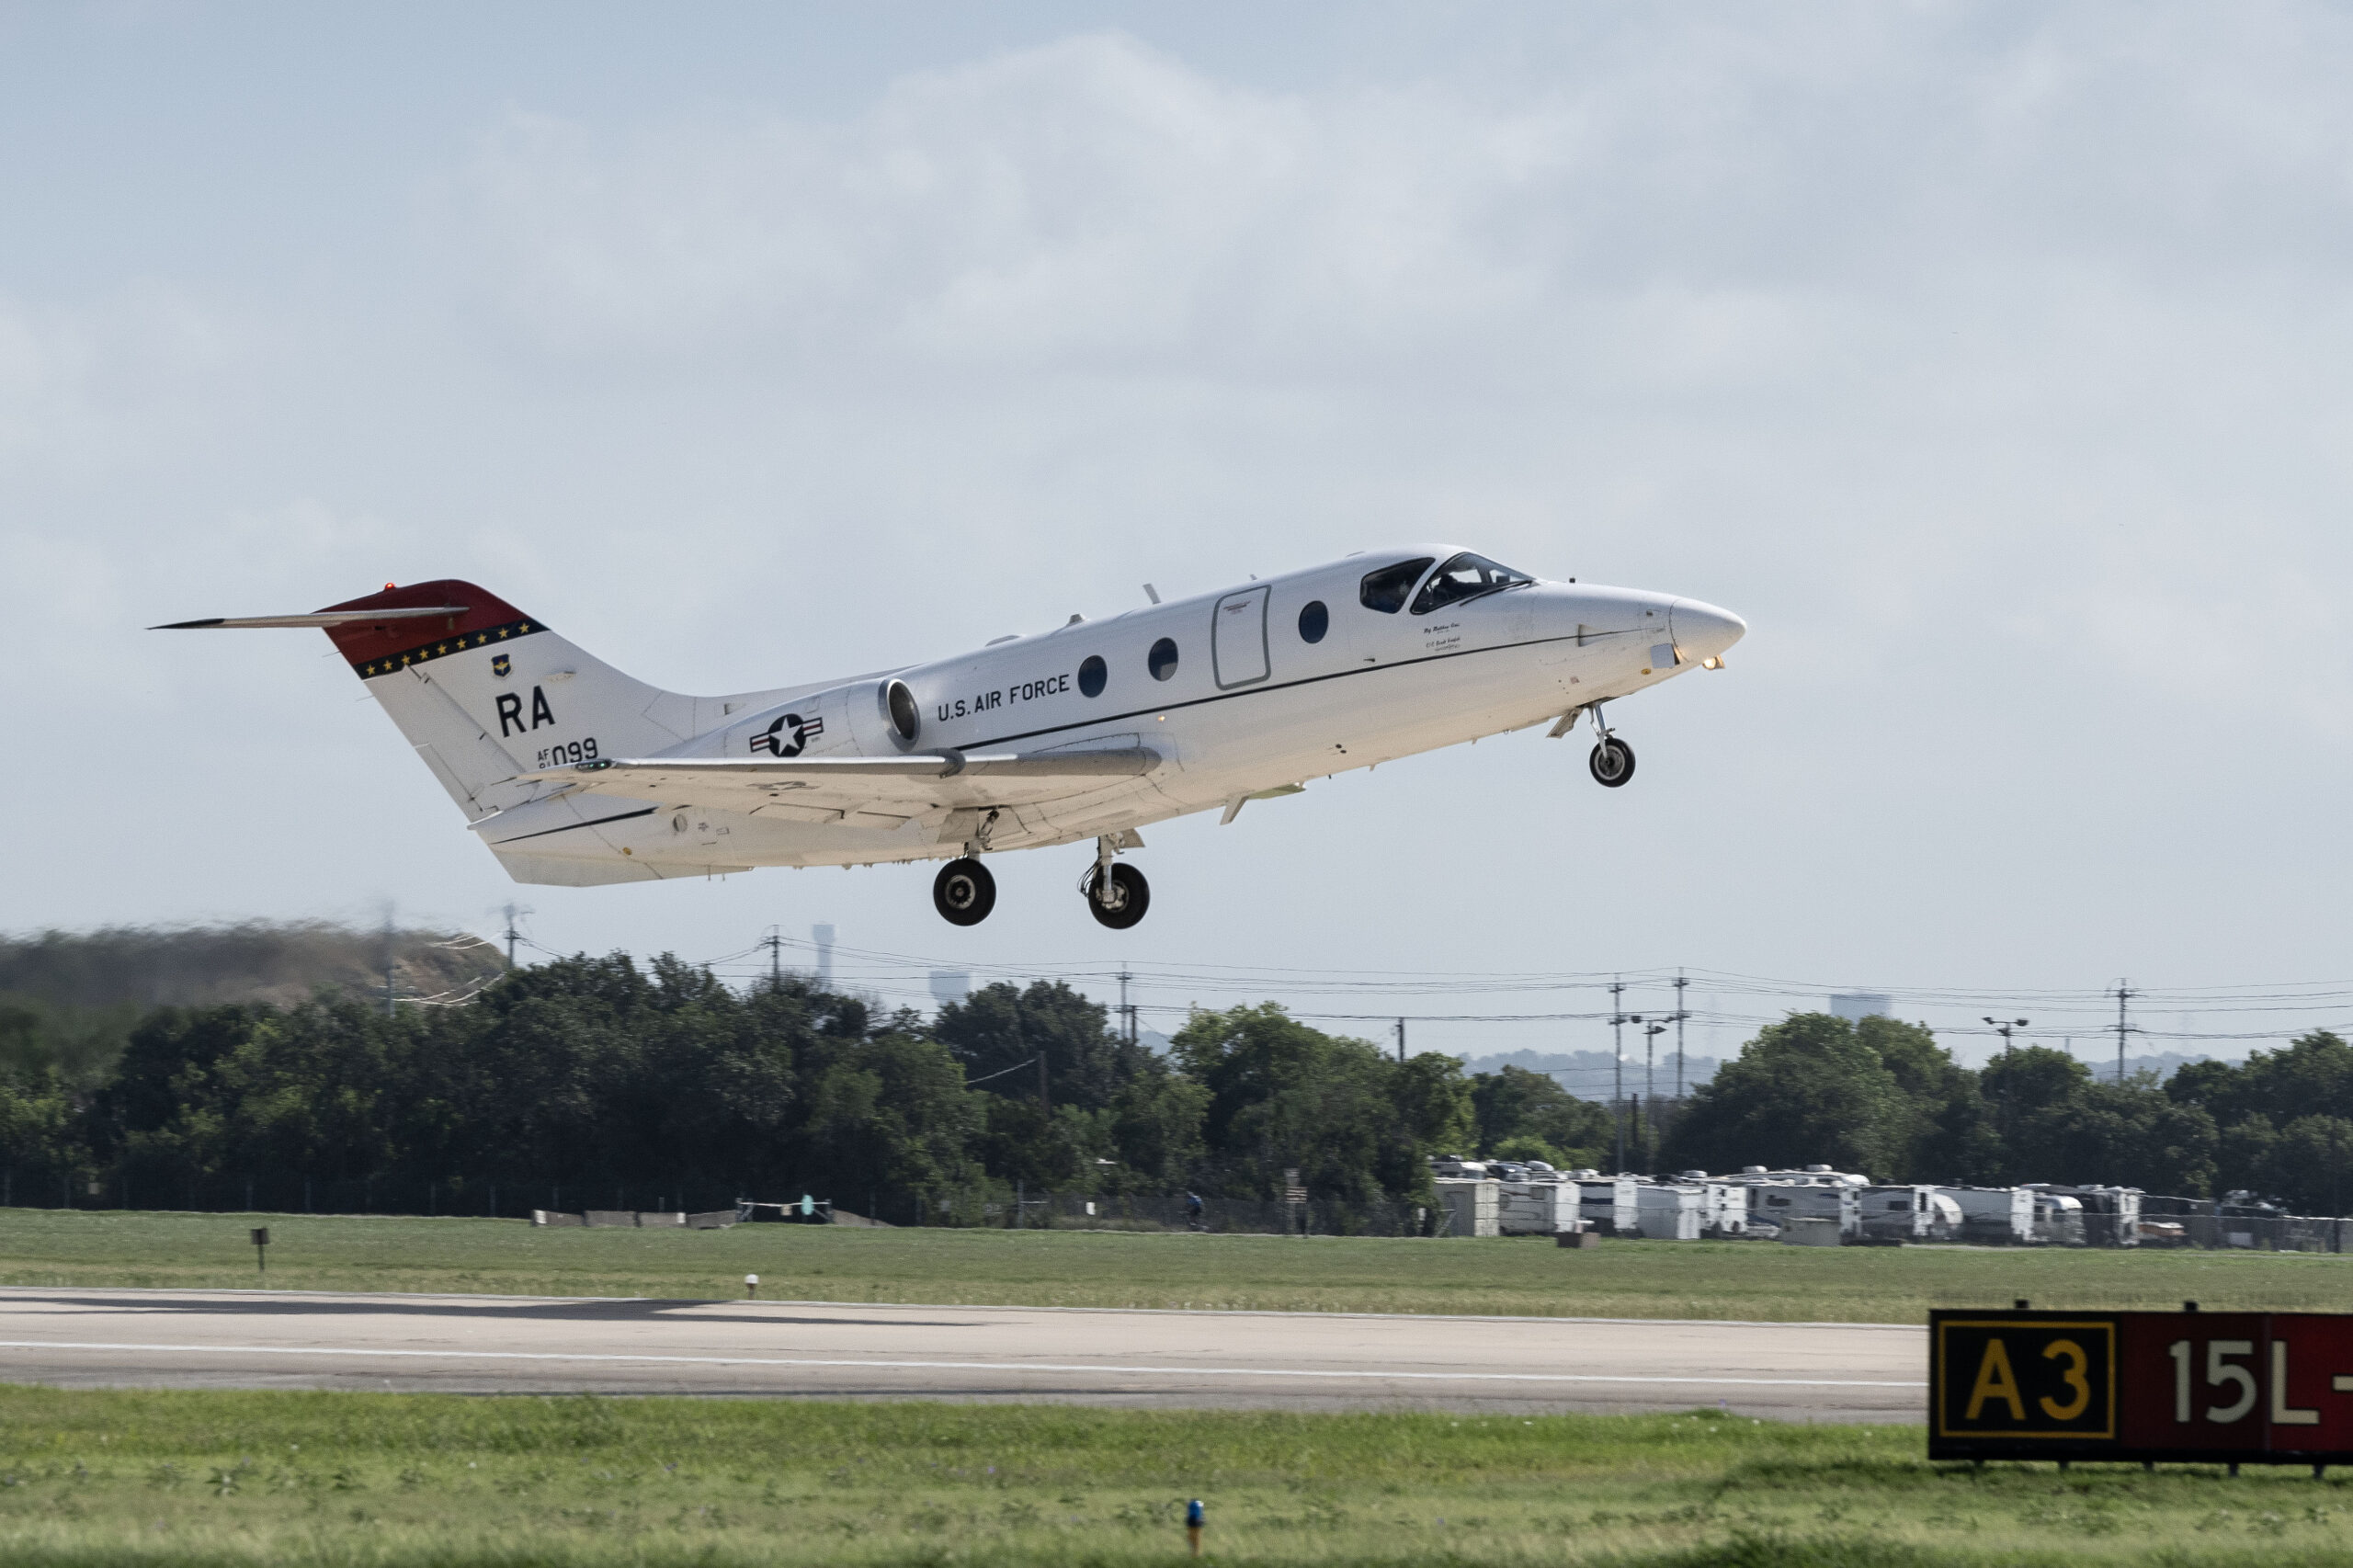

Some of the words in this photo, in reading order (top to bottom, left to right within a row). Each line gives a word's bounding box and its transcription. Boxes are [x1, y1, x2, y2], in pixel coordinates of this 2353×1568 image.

[494, 684, 556, 738] RA
[938, 699, 971, 722] U.S.
[974, 689, 1002, 713] AIR
[1009, 673, 1071, 706] FORCE
[538, 748, 551, 762] AF
[552, 736, 599, 767] 099
[1965, 1337, 2092, 1422] A3
